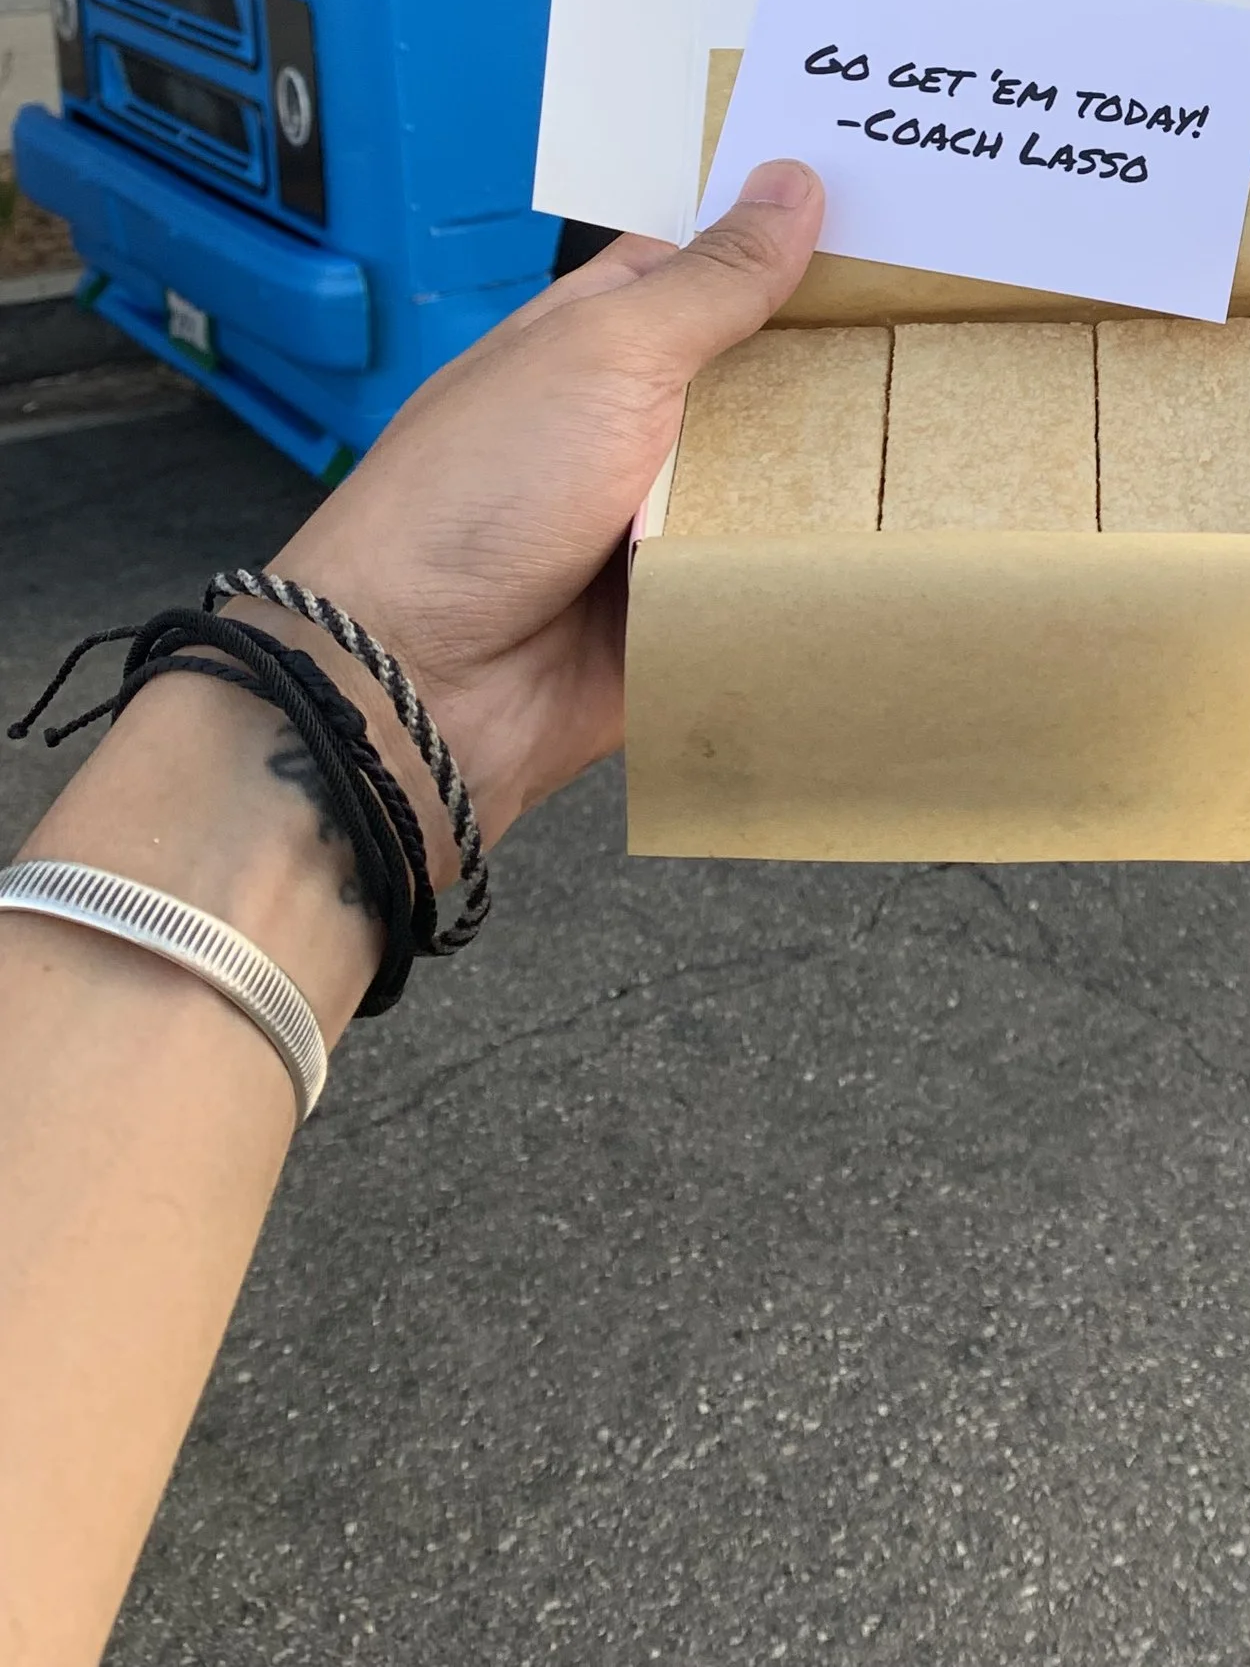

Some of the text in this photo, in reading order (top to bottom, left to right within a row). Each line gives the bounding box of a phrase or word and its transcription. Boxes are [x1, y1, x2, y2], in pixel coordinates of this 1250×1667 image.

[804, 45, 1209, 139] GO GET 'EM TODAY!
[1018, 133, 1150, 184] LASSO
